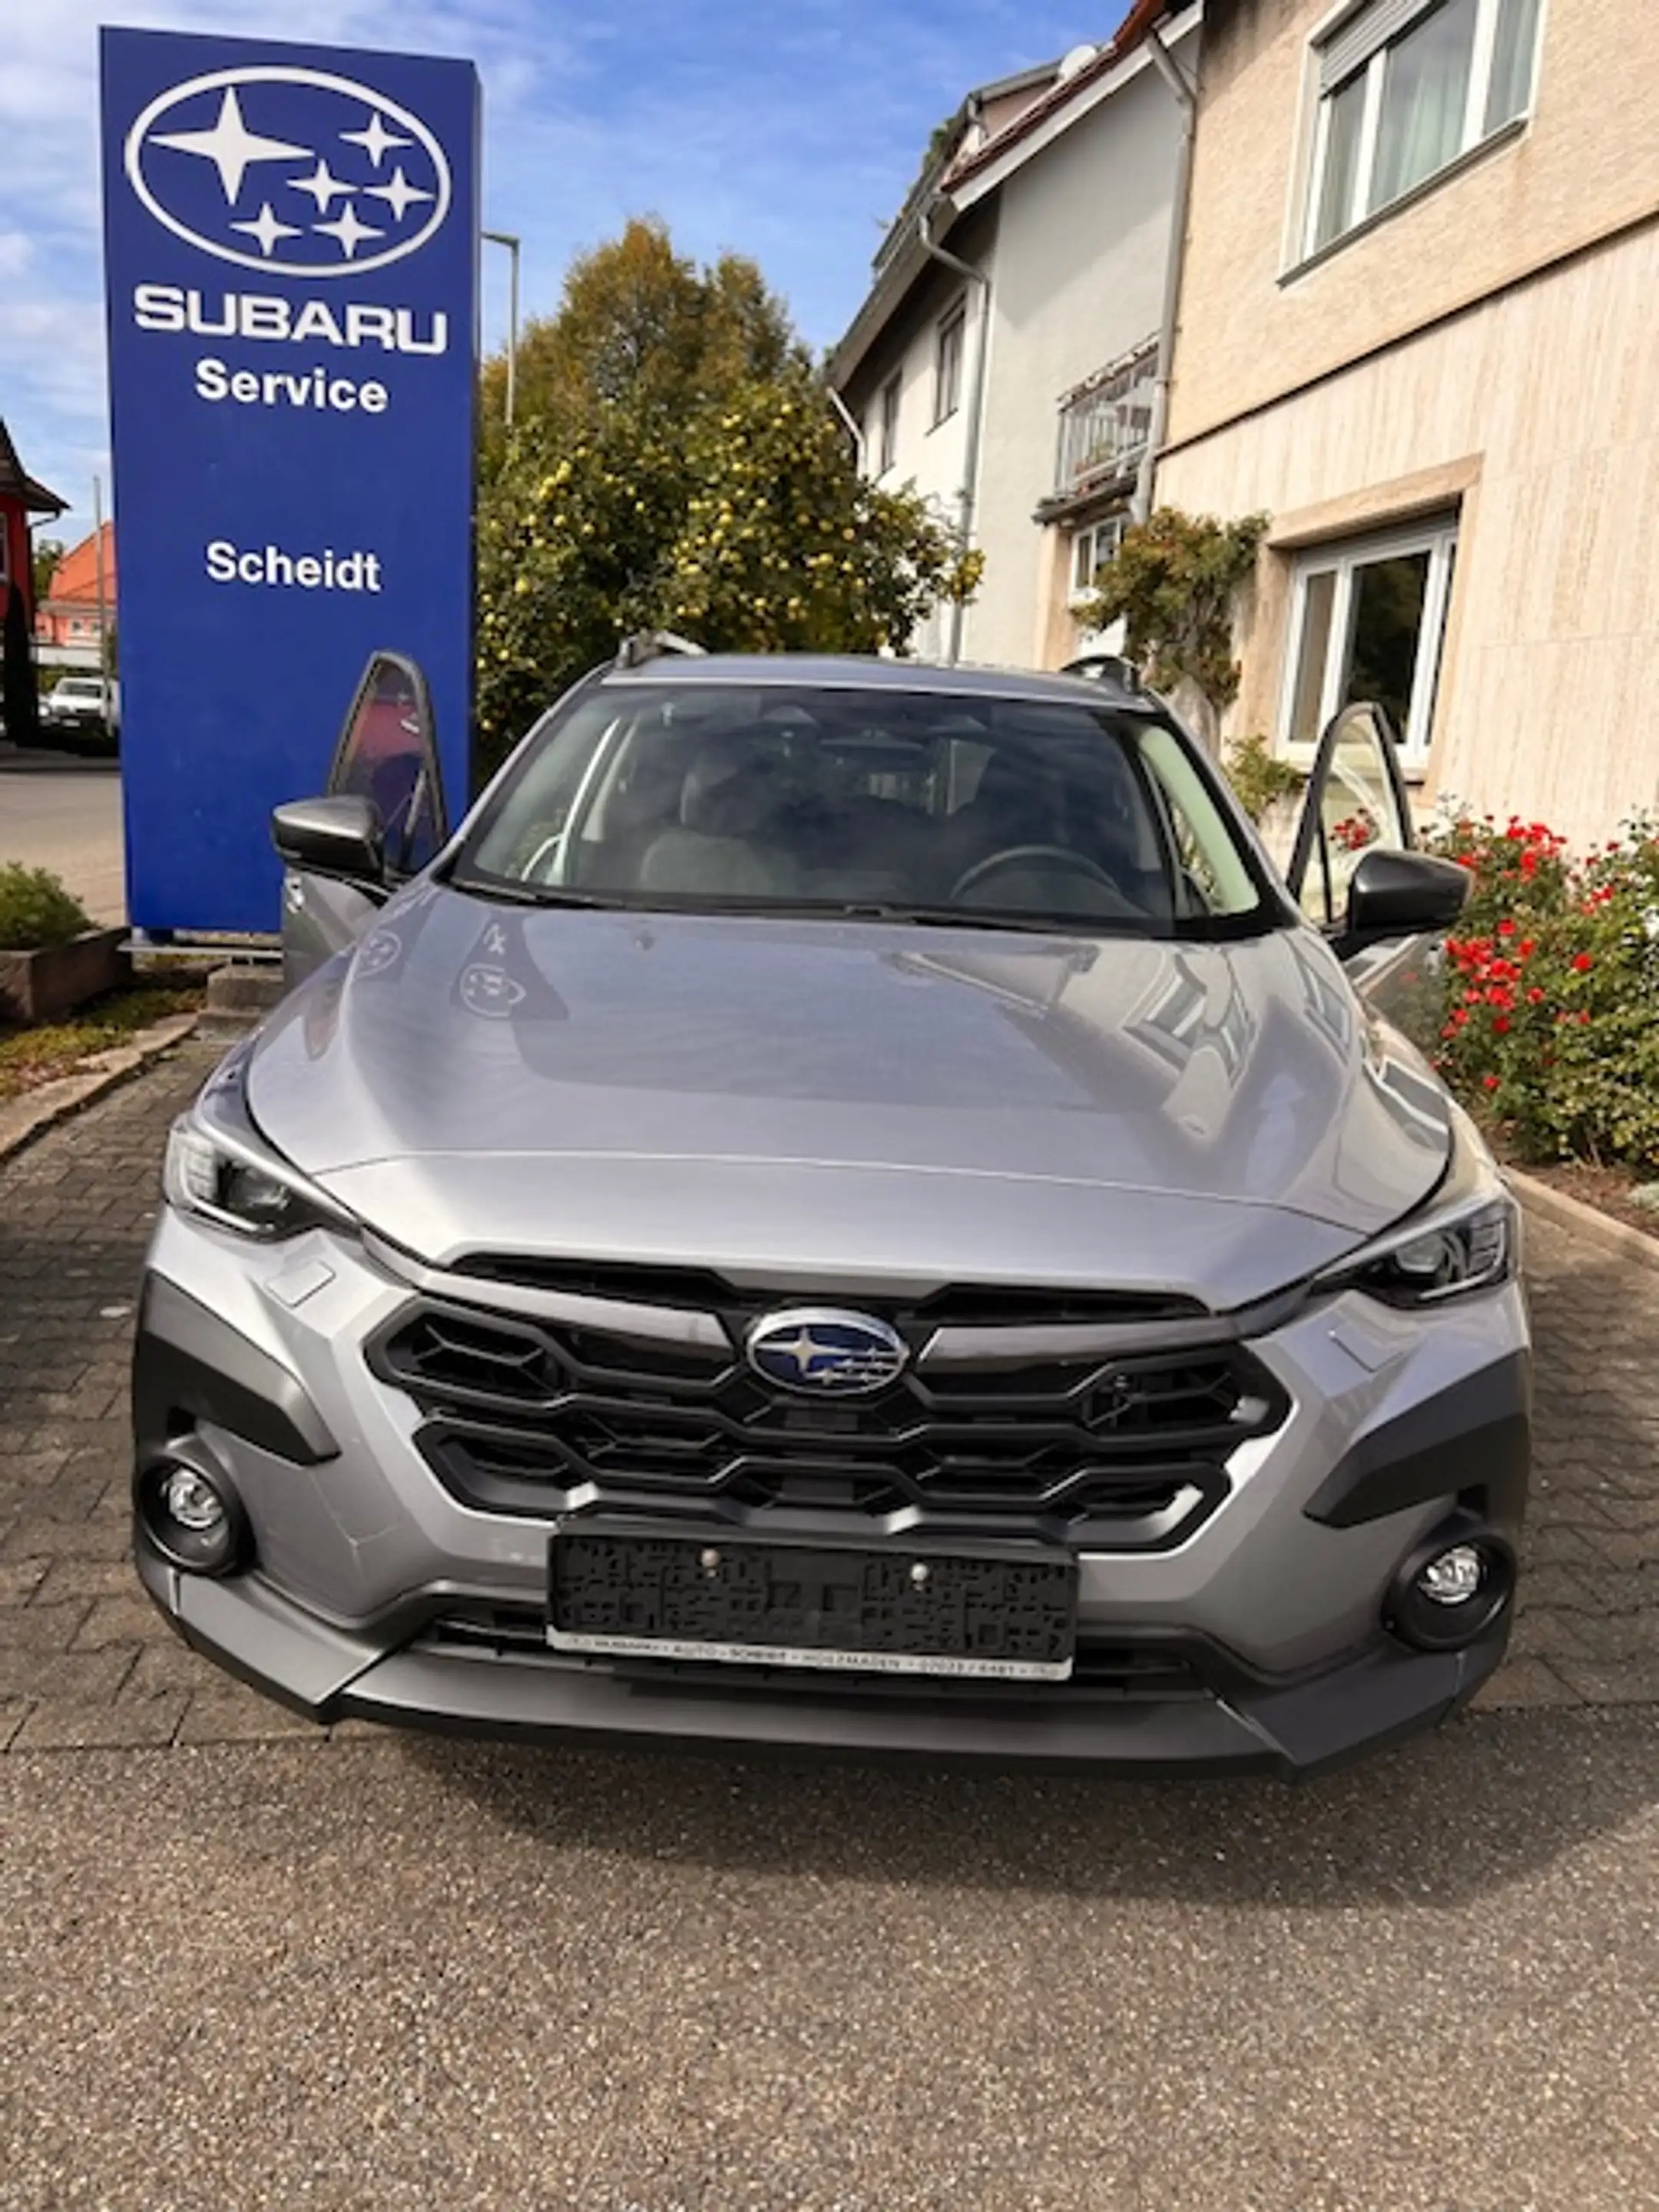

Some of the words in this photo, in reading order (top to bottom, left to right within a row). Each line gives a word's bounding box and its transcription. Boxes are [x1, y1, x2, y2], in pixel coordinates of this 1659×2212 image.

[134, 284, 447, 355] SUBARU
[195, 359, 388, 413] Service
[206, 541, 381, 591] Scheidt
